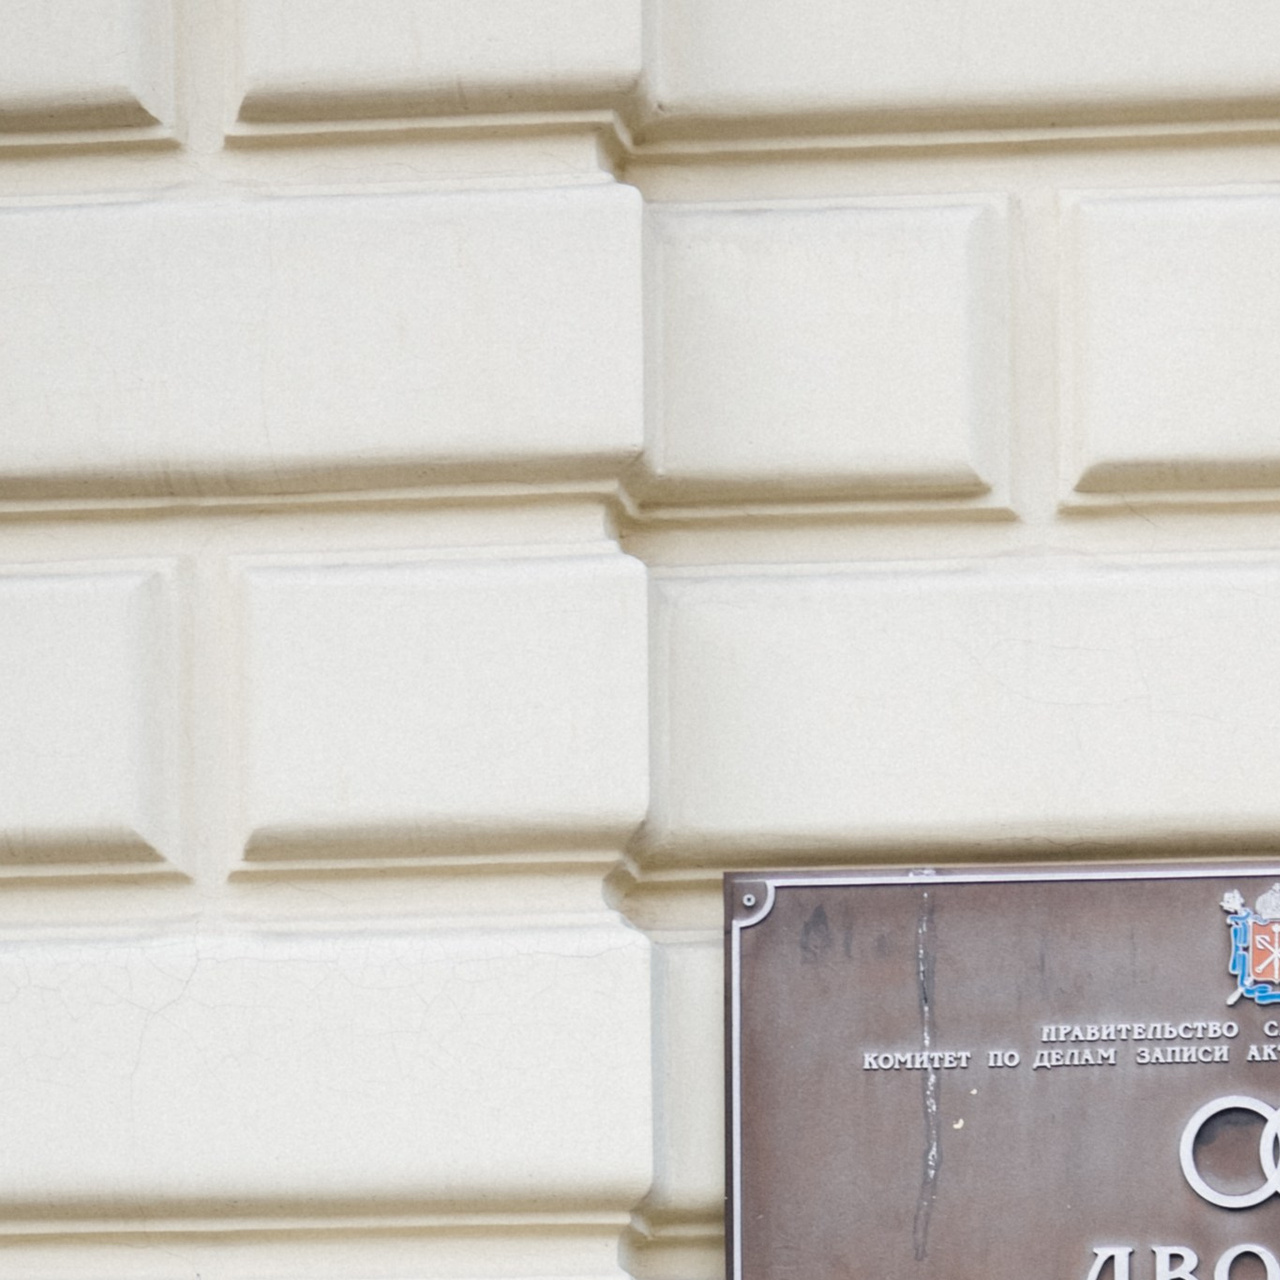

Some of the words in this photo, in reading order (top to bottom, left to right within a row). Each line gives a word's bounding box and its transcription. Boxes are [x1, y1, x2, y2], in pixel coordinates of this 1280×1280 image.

[1040, 1021, 1239, 1042] ПРАВИТЕЛЬСТВО
[863, 1051, 971, 1070] КОМИТЕТ
[988, 1050, 1021, 1068] ПО
[1033, 1047, 1118, 1069] ДЕЛАМ
[1136, 1045, 1230, 1064] ЗАПИСИ
